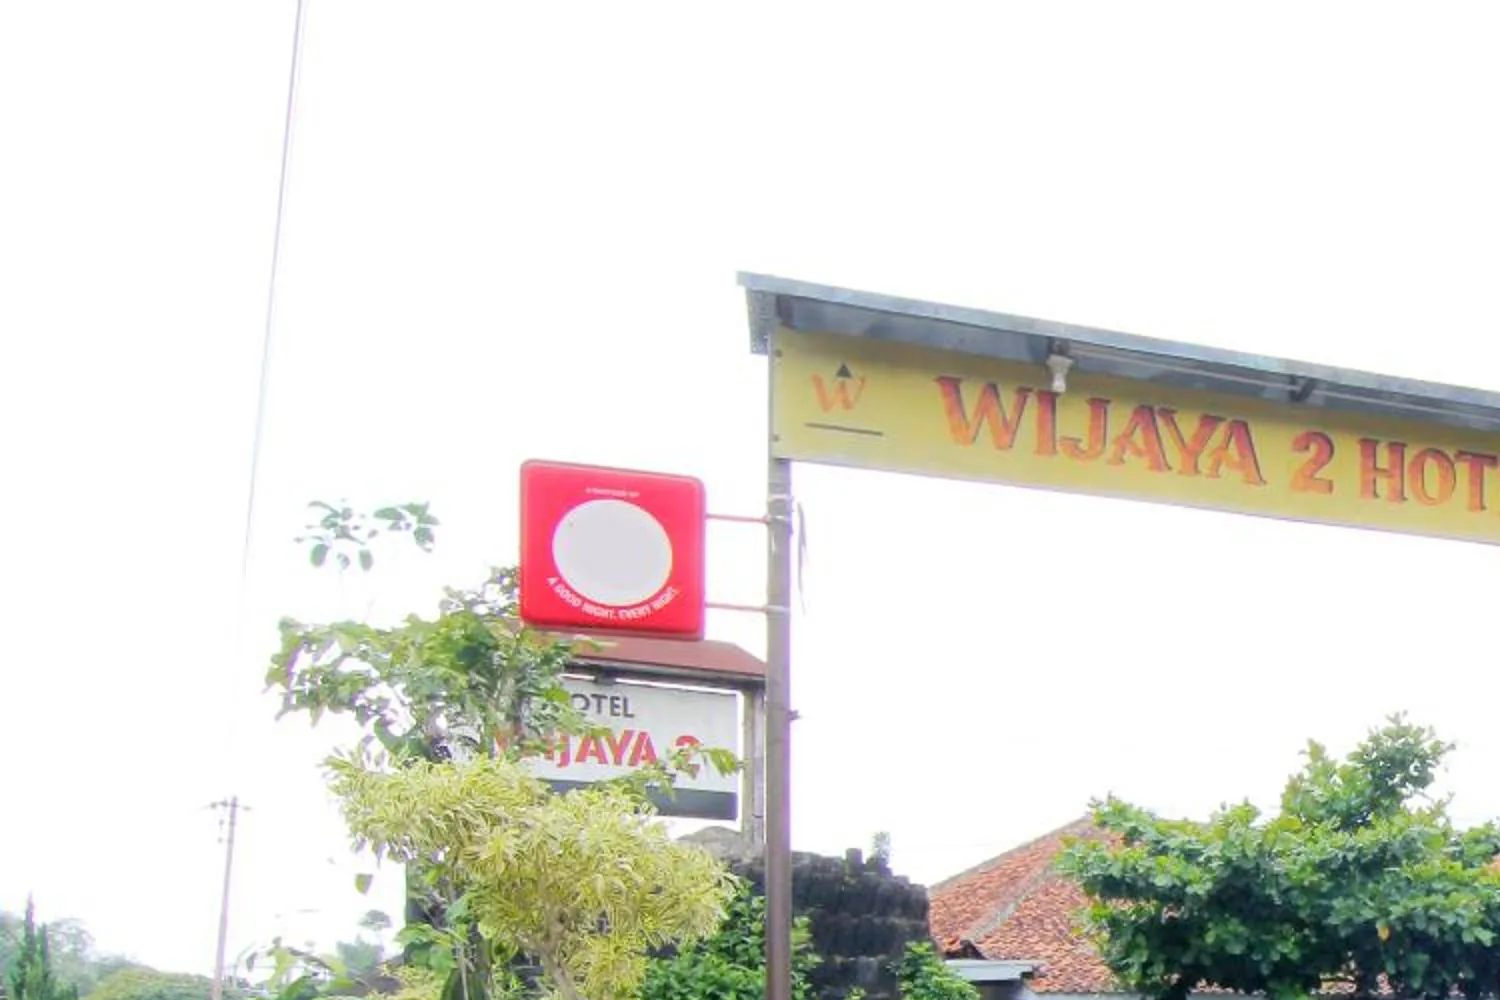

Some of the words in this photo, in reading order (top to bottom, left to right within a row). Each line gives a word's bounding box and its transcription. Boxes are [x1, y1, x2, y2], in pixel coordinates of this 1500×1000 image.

[935, 376, 1266, 486] WIJAYA
[1291, 430, 1335, 495] 2
[569, 693, 635, 718] OTEL
